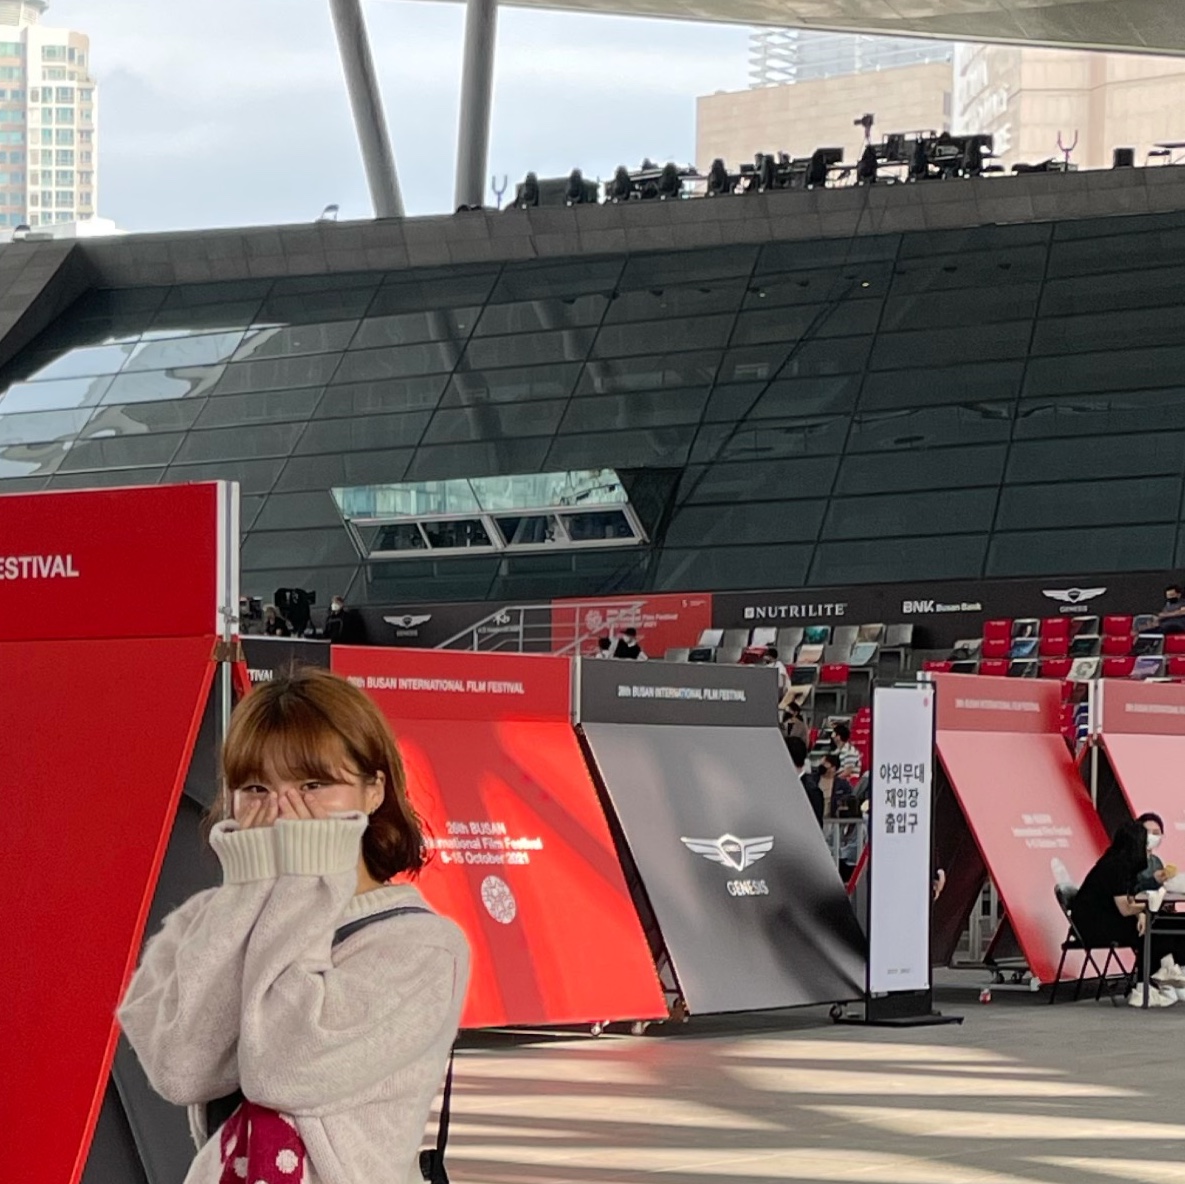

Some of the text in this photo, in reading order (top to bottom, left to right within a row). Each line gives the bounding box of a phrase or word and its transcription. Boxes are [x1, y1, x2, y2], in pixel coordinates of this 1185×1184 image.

[756, 603, 845, 619] NUTRILITE
[903, 600, 934, 613] BNK
[246, 668, 274, 681] TIVAL
[367, 676, 397, 689] BUSAN
[398, 678, 465, 692] INTERNATIONAL
[466, 680, 486, 693] FILM
[487, 681, 525, 694] FESTIVAL
[879, 762, 925, 784] 야외무대
[885, 788, 919, 809] 재입장
[885, 812, 918, 834] 출입구
[726, 879, 769, 896] GENESIS
